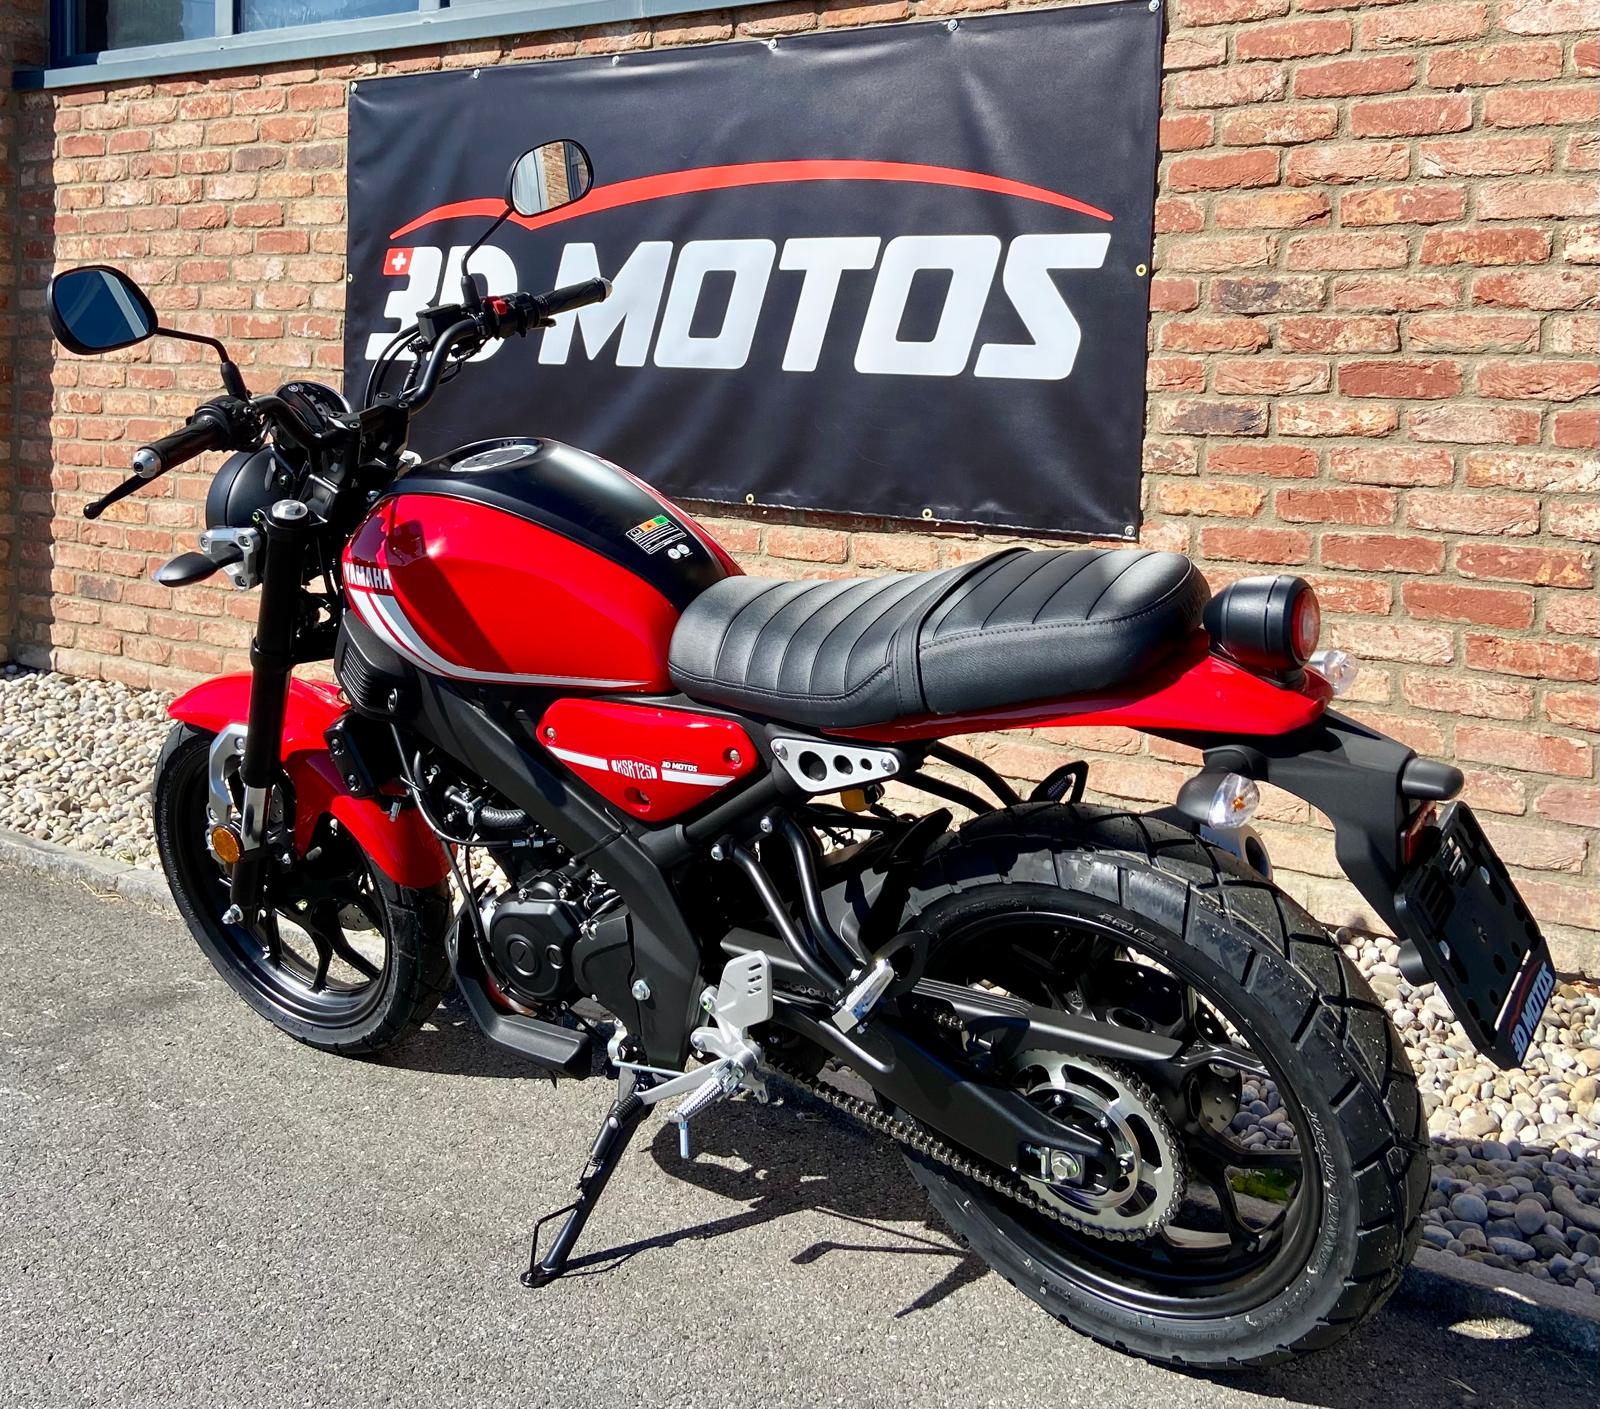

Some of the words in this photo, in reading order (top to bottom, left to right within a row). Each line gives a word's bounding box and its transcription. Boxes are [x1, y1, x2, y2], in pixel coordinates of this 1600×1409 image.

[365, 246, 518, 362] 3D
[538, 232, 1111, 380] MOTOS
[343, 561, 394, 590] YAMAHA
[615, 759, 654, 779] XSR125
[671, 762, 698, 772] MOTOS
[1520, 961, 1554, 1037] MOTOS
